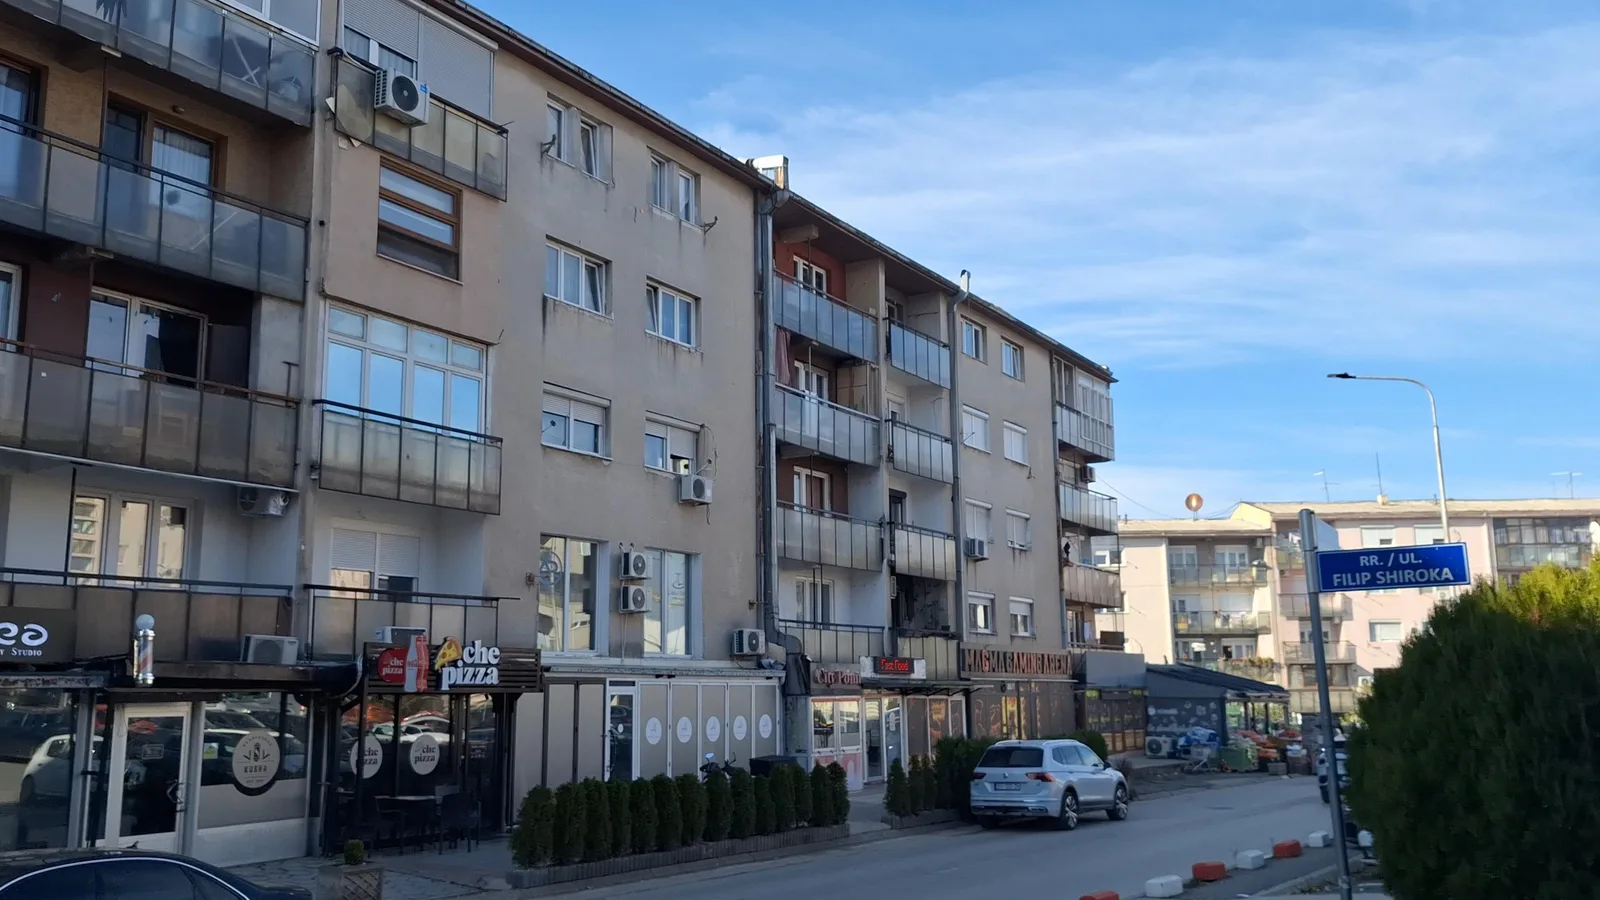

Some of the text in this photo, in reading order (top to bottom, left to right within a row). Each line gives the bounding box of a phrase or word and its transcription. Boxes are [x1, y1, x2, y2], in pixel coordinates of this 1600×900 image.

[1359, 553, 1423, 567] RR. / UL.
[1332, 568, 1455, 586] FILIP SHIROKA
[463, 640, 501, 664] che
[964, 649, 1073, 675] MAGMA GAMING ARENA
[441, 660, 500, 691] pizza
